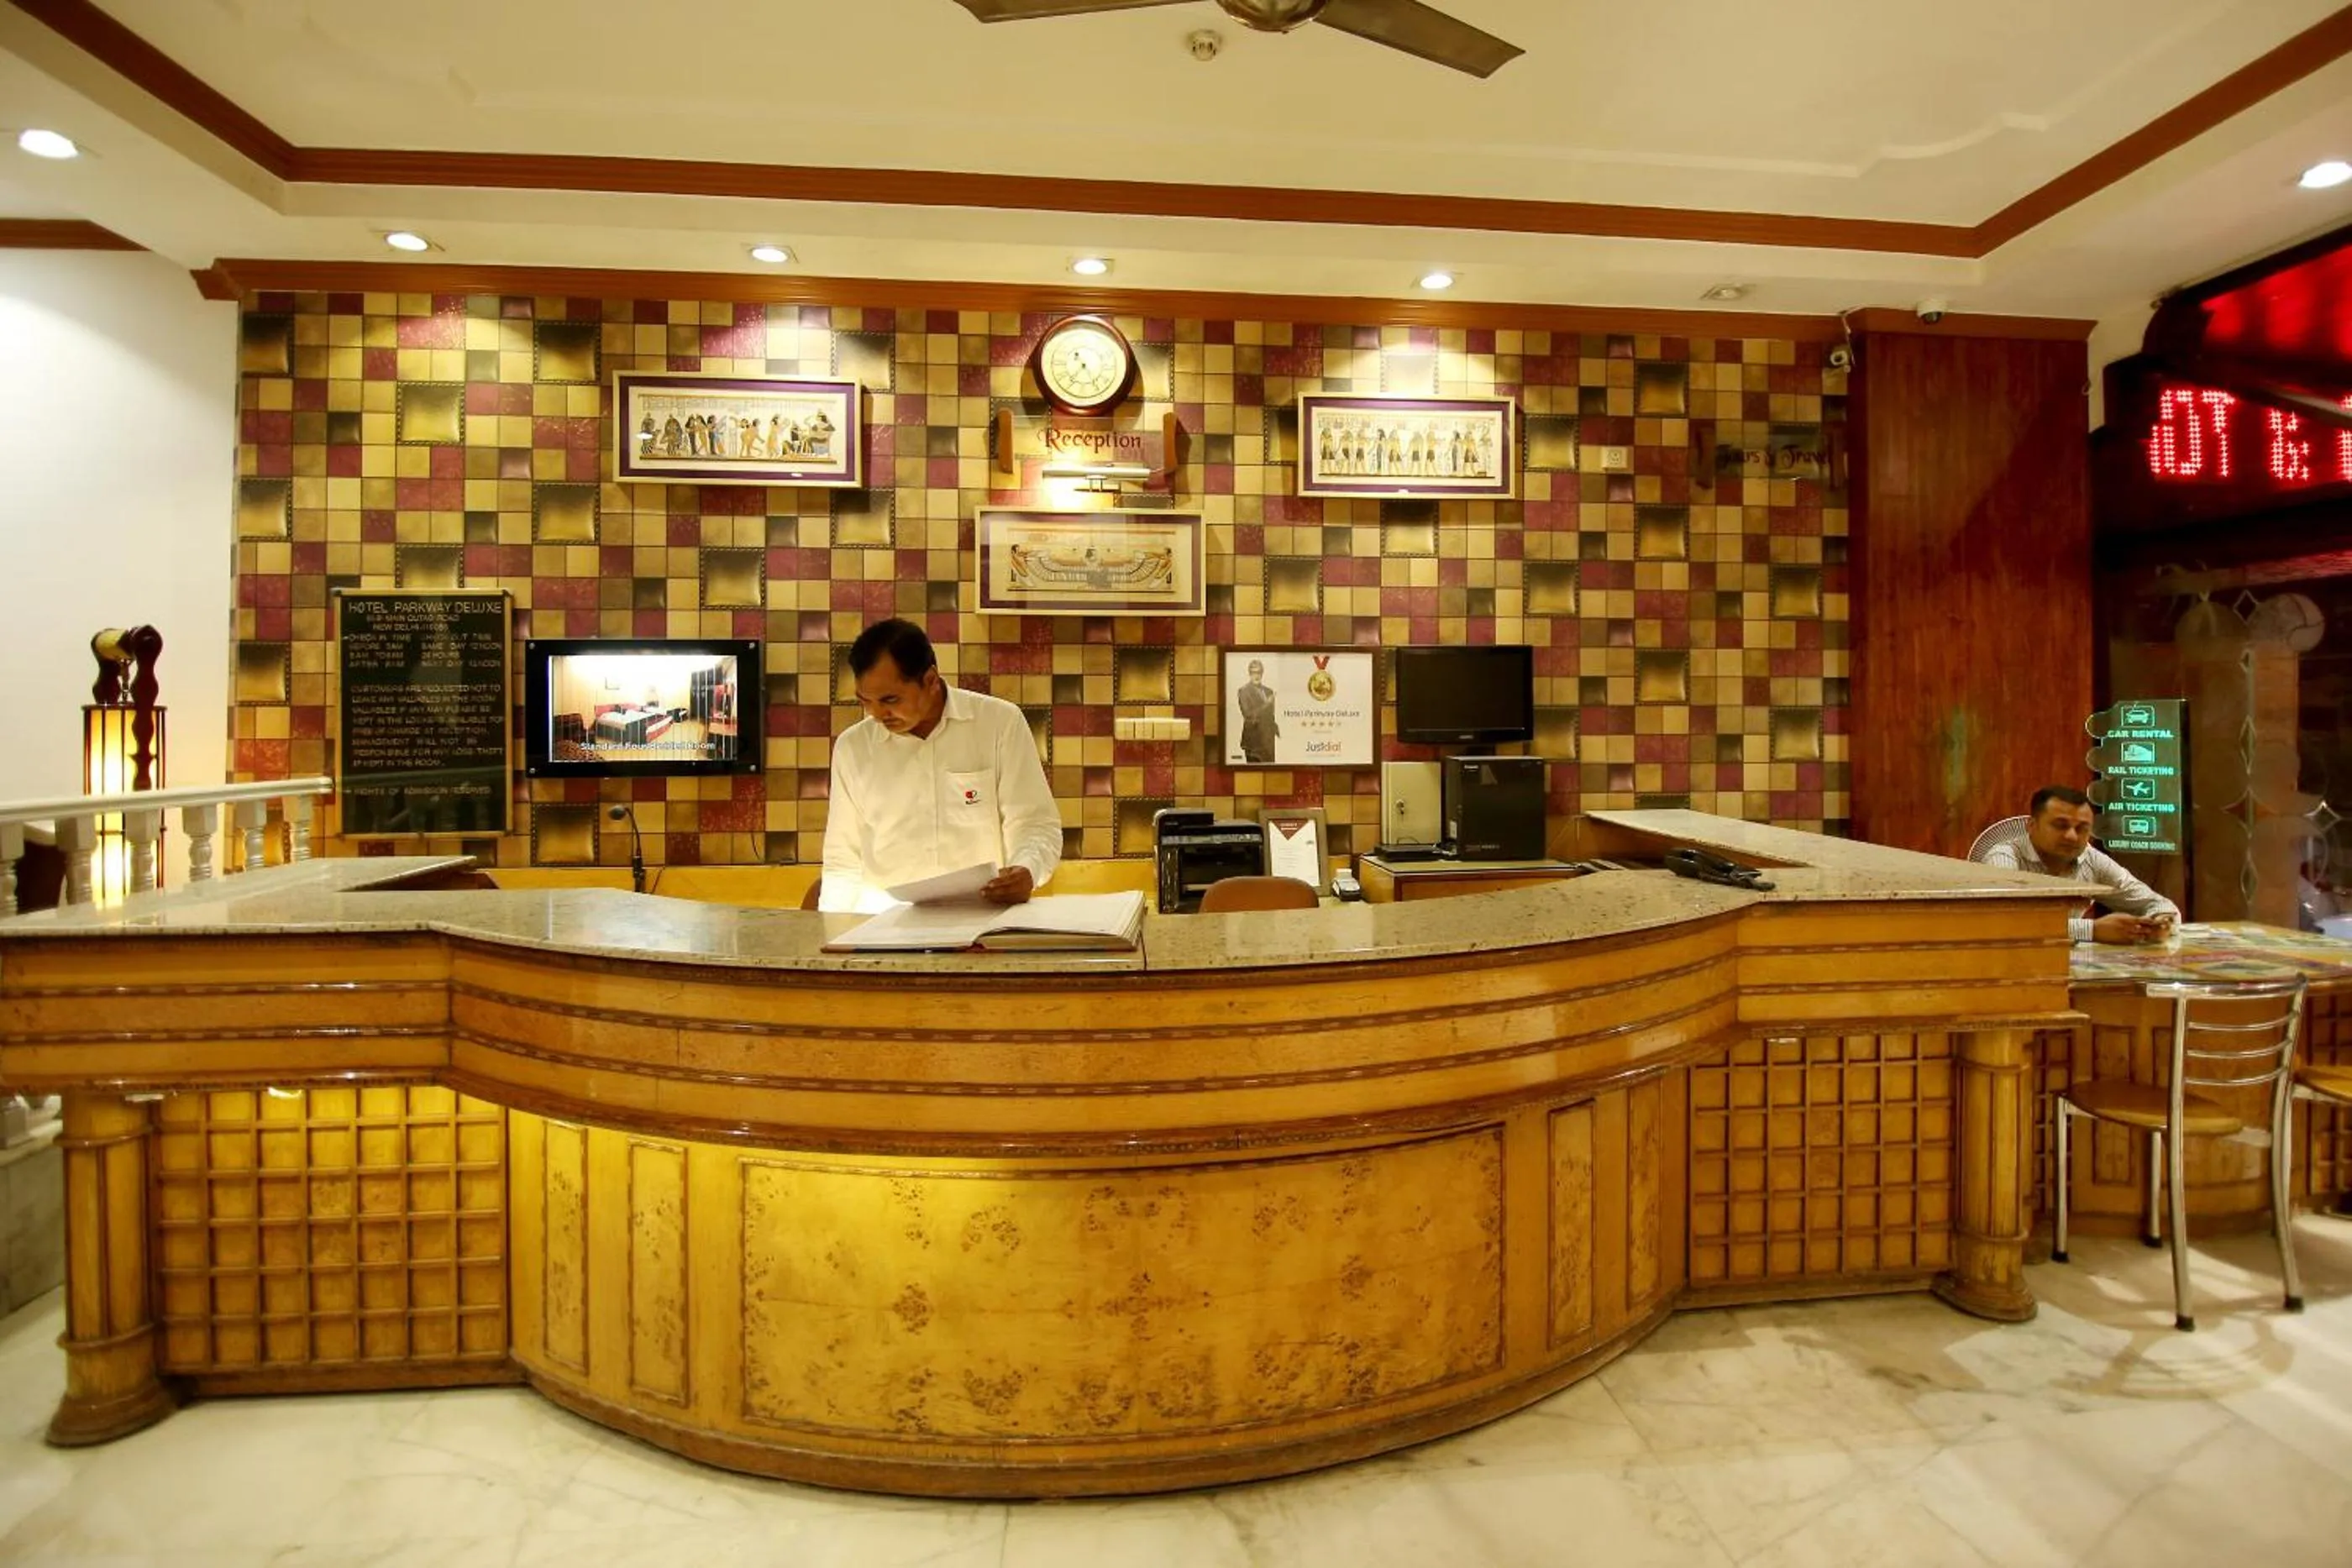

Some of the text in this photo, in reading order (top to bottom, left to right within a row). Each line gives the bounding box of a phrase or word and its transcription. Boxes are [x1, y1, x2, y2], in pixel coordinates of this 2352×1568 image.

[1037, 427, 1142, 454] Reception
[348, 601, 502, 614] HOTEL PARKWAY DELUXE
[449, 642, 467, 650] DAY
[490, 684, 501, 693] TO
[2108, 730, 2174, 738] CAR RENTAL
[2108, 766, 2175, 775] RAIL TICKETING
[2108, 802, 2176, 813] AIR TICKETING
